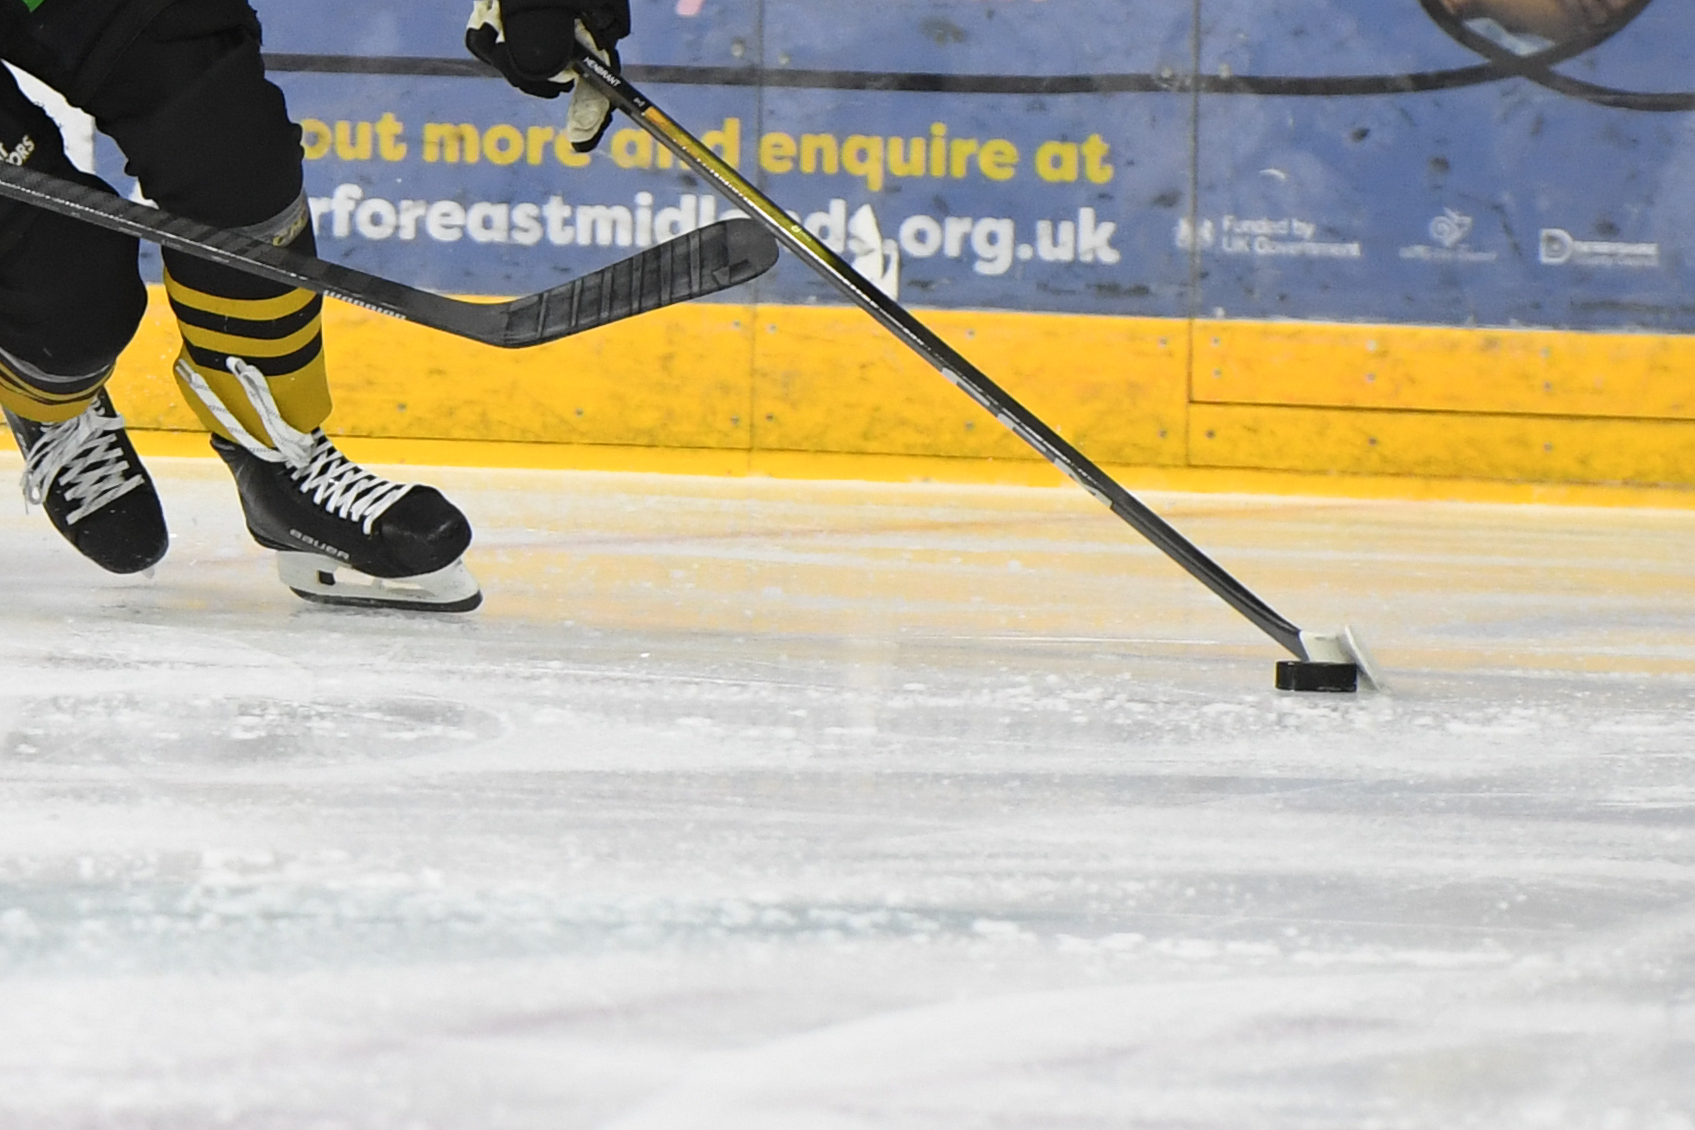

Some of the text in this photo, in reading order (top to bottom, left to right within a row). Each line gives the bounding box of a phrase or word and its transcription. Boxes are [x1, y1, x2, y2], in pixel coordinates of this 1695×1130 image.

[422, 122, 592, 167] more
[760, 122, 1019, 191] enquire
[1035, 133, 1114, 184] at
